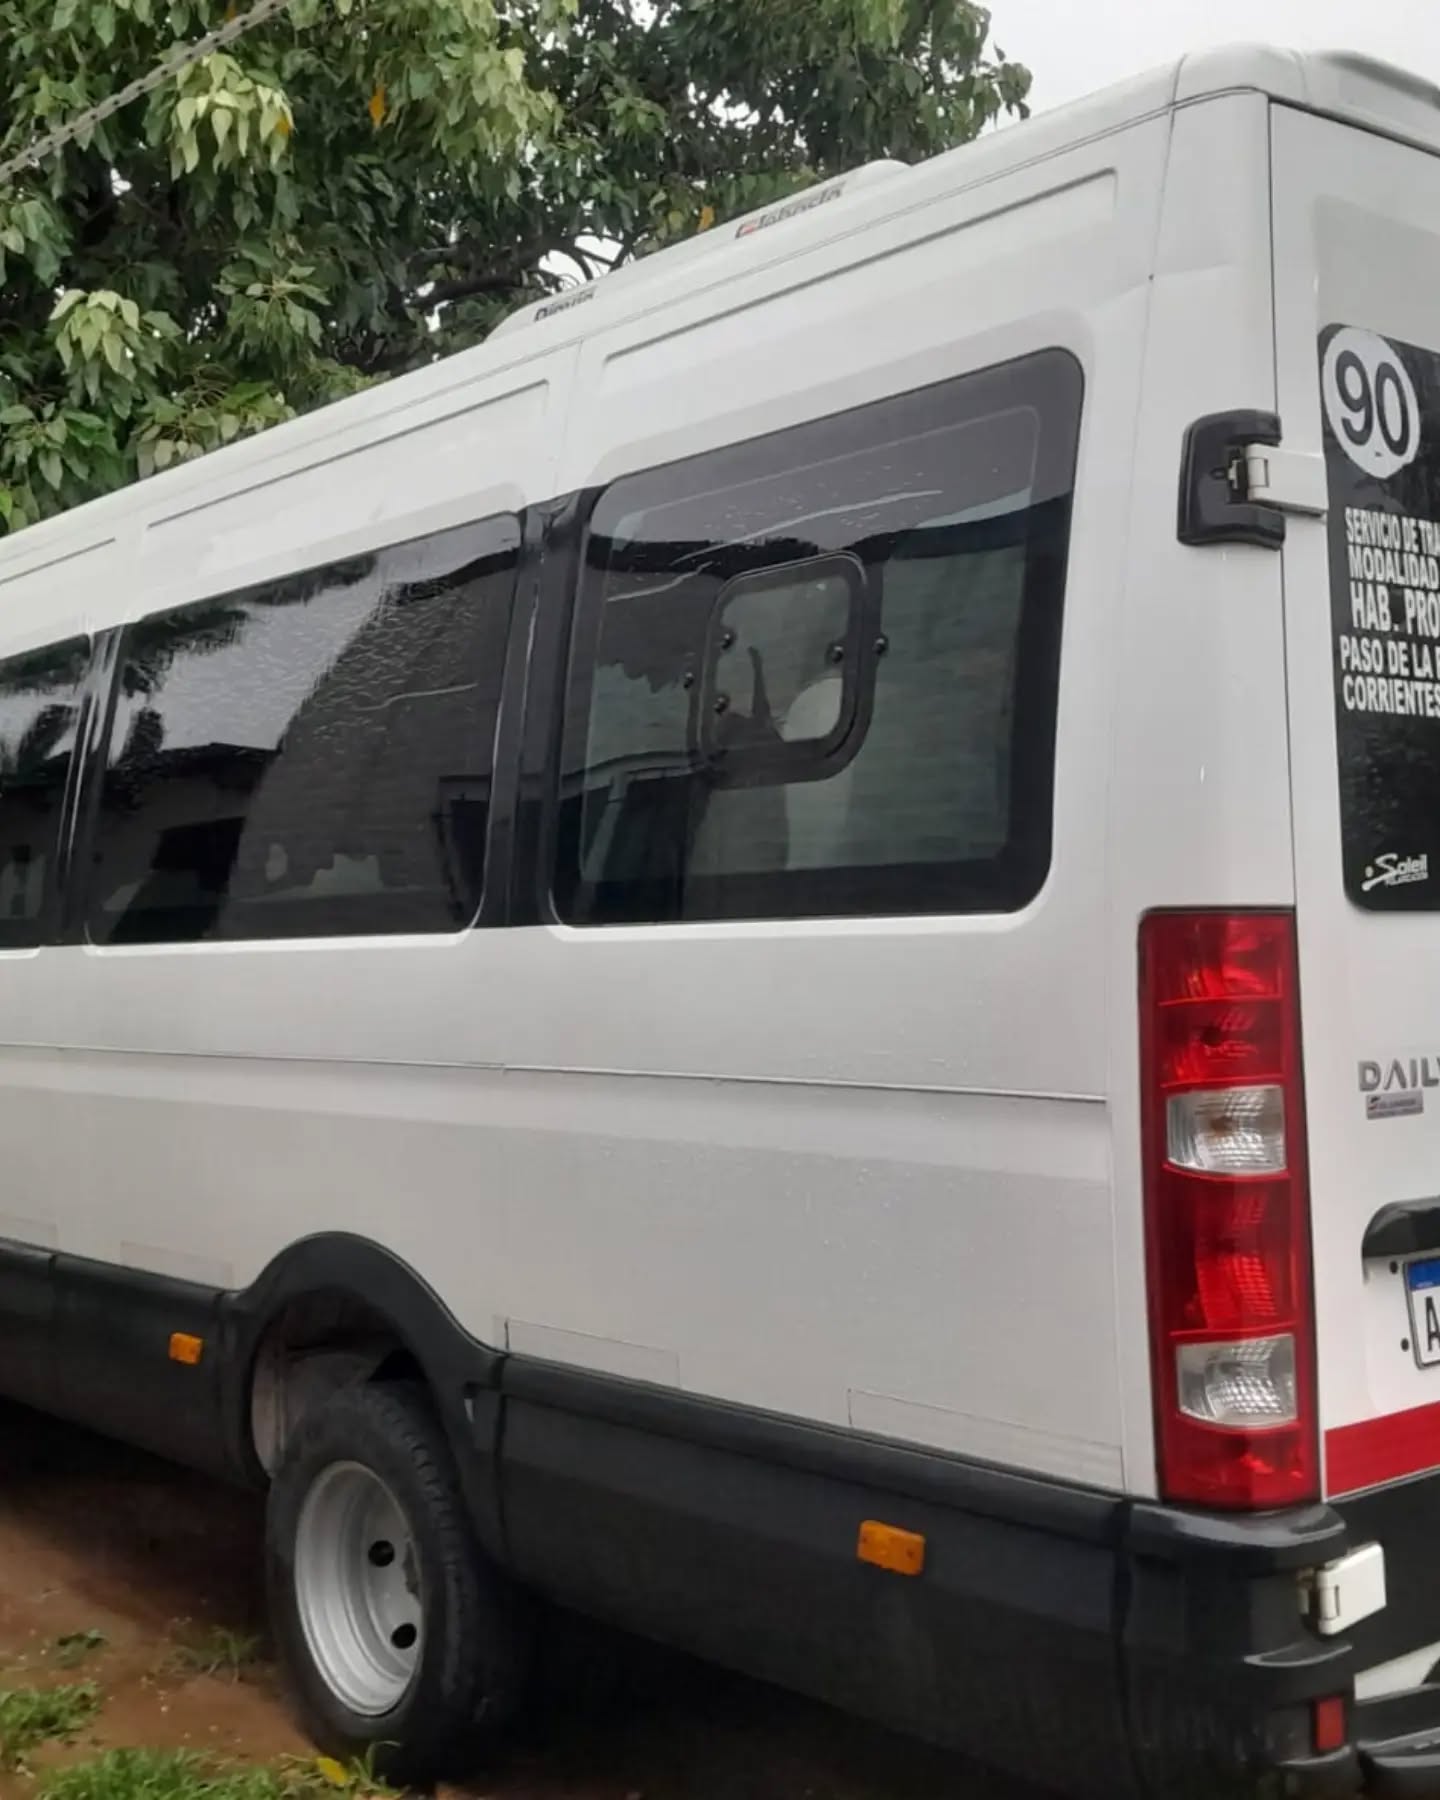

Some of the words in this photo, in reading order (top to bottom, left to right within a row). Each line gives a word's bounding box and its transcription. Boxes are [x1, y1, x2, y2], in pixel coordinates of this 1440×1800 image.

[1336, 350, 1410, 457] 90
[1345, 507, 1400, 550] SERVICIO
[1402, 516, 1420, 553] DE
[1349, 545, 1439, 590] MODALIDAD
[1350, 580, 1399, 632] HAB.
[1404, 588, 1440, 639] PRO
[1339, 635, 1383, 674] PASO
[1387, 640, 1409, 677] DE
[1412, 642, 1434, 679] LA
[1343, 674, 1440, 718] CORRIENTES
[1359, 1056, 1440, 1092] DAIL
